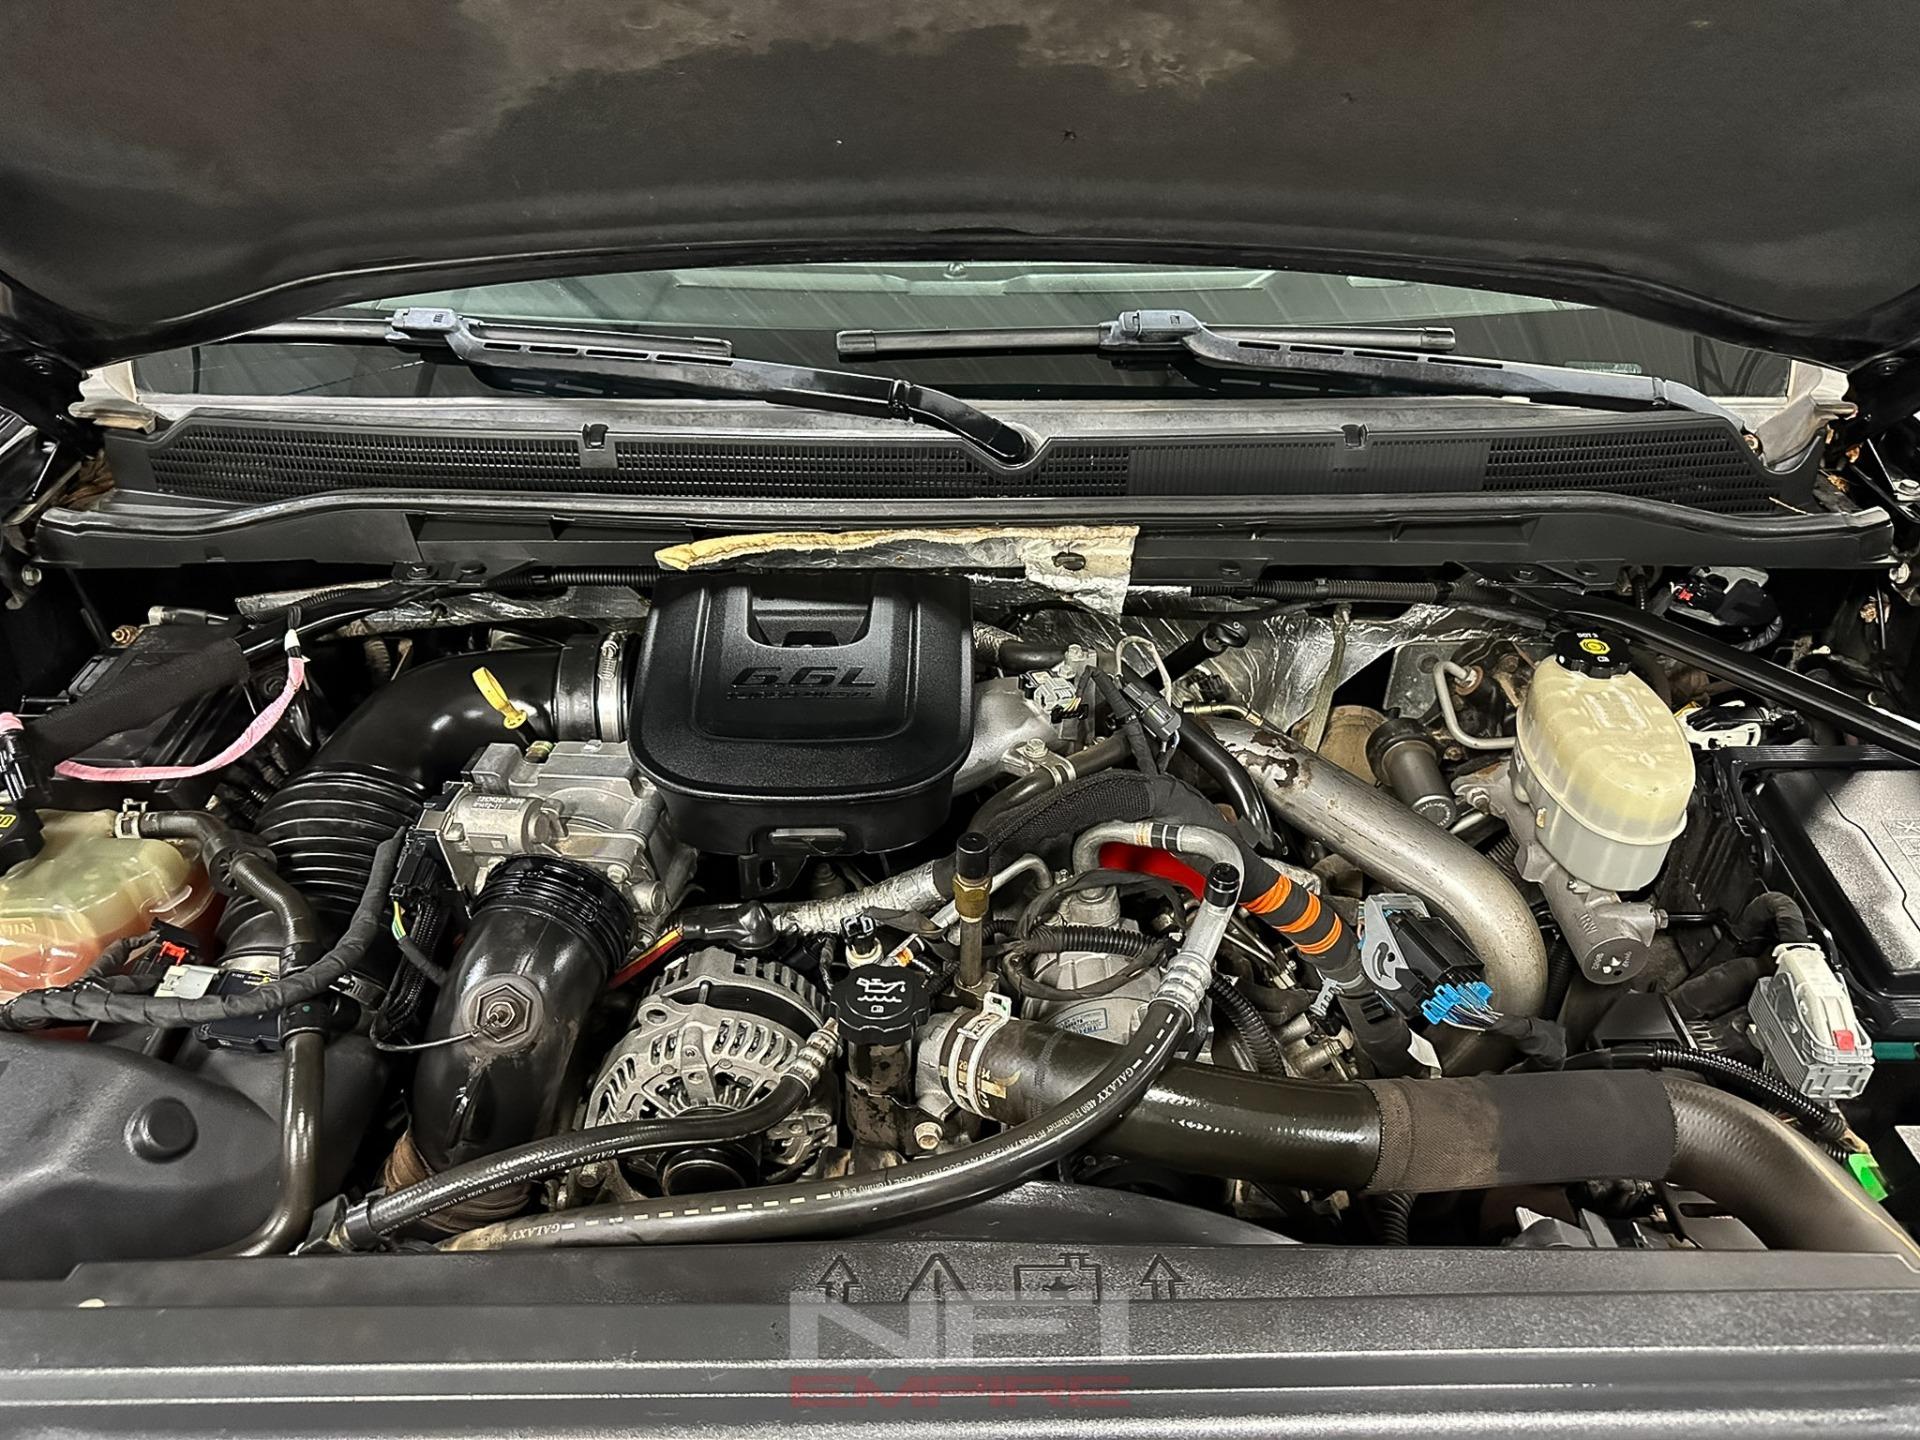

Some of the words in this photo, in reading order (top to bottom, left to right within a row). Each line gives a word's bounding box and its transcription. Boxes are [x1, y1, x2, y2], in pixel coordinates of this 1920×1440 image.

[731, 666, 877, 687] 6.6L
[1096, 1067, 1135, 1104] GALAXY
[569, 1148, 616, 1165] GALAXY
[507, 1222, 560, 1241] GALAXY
